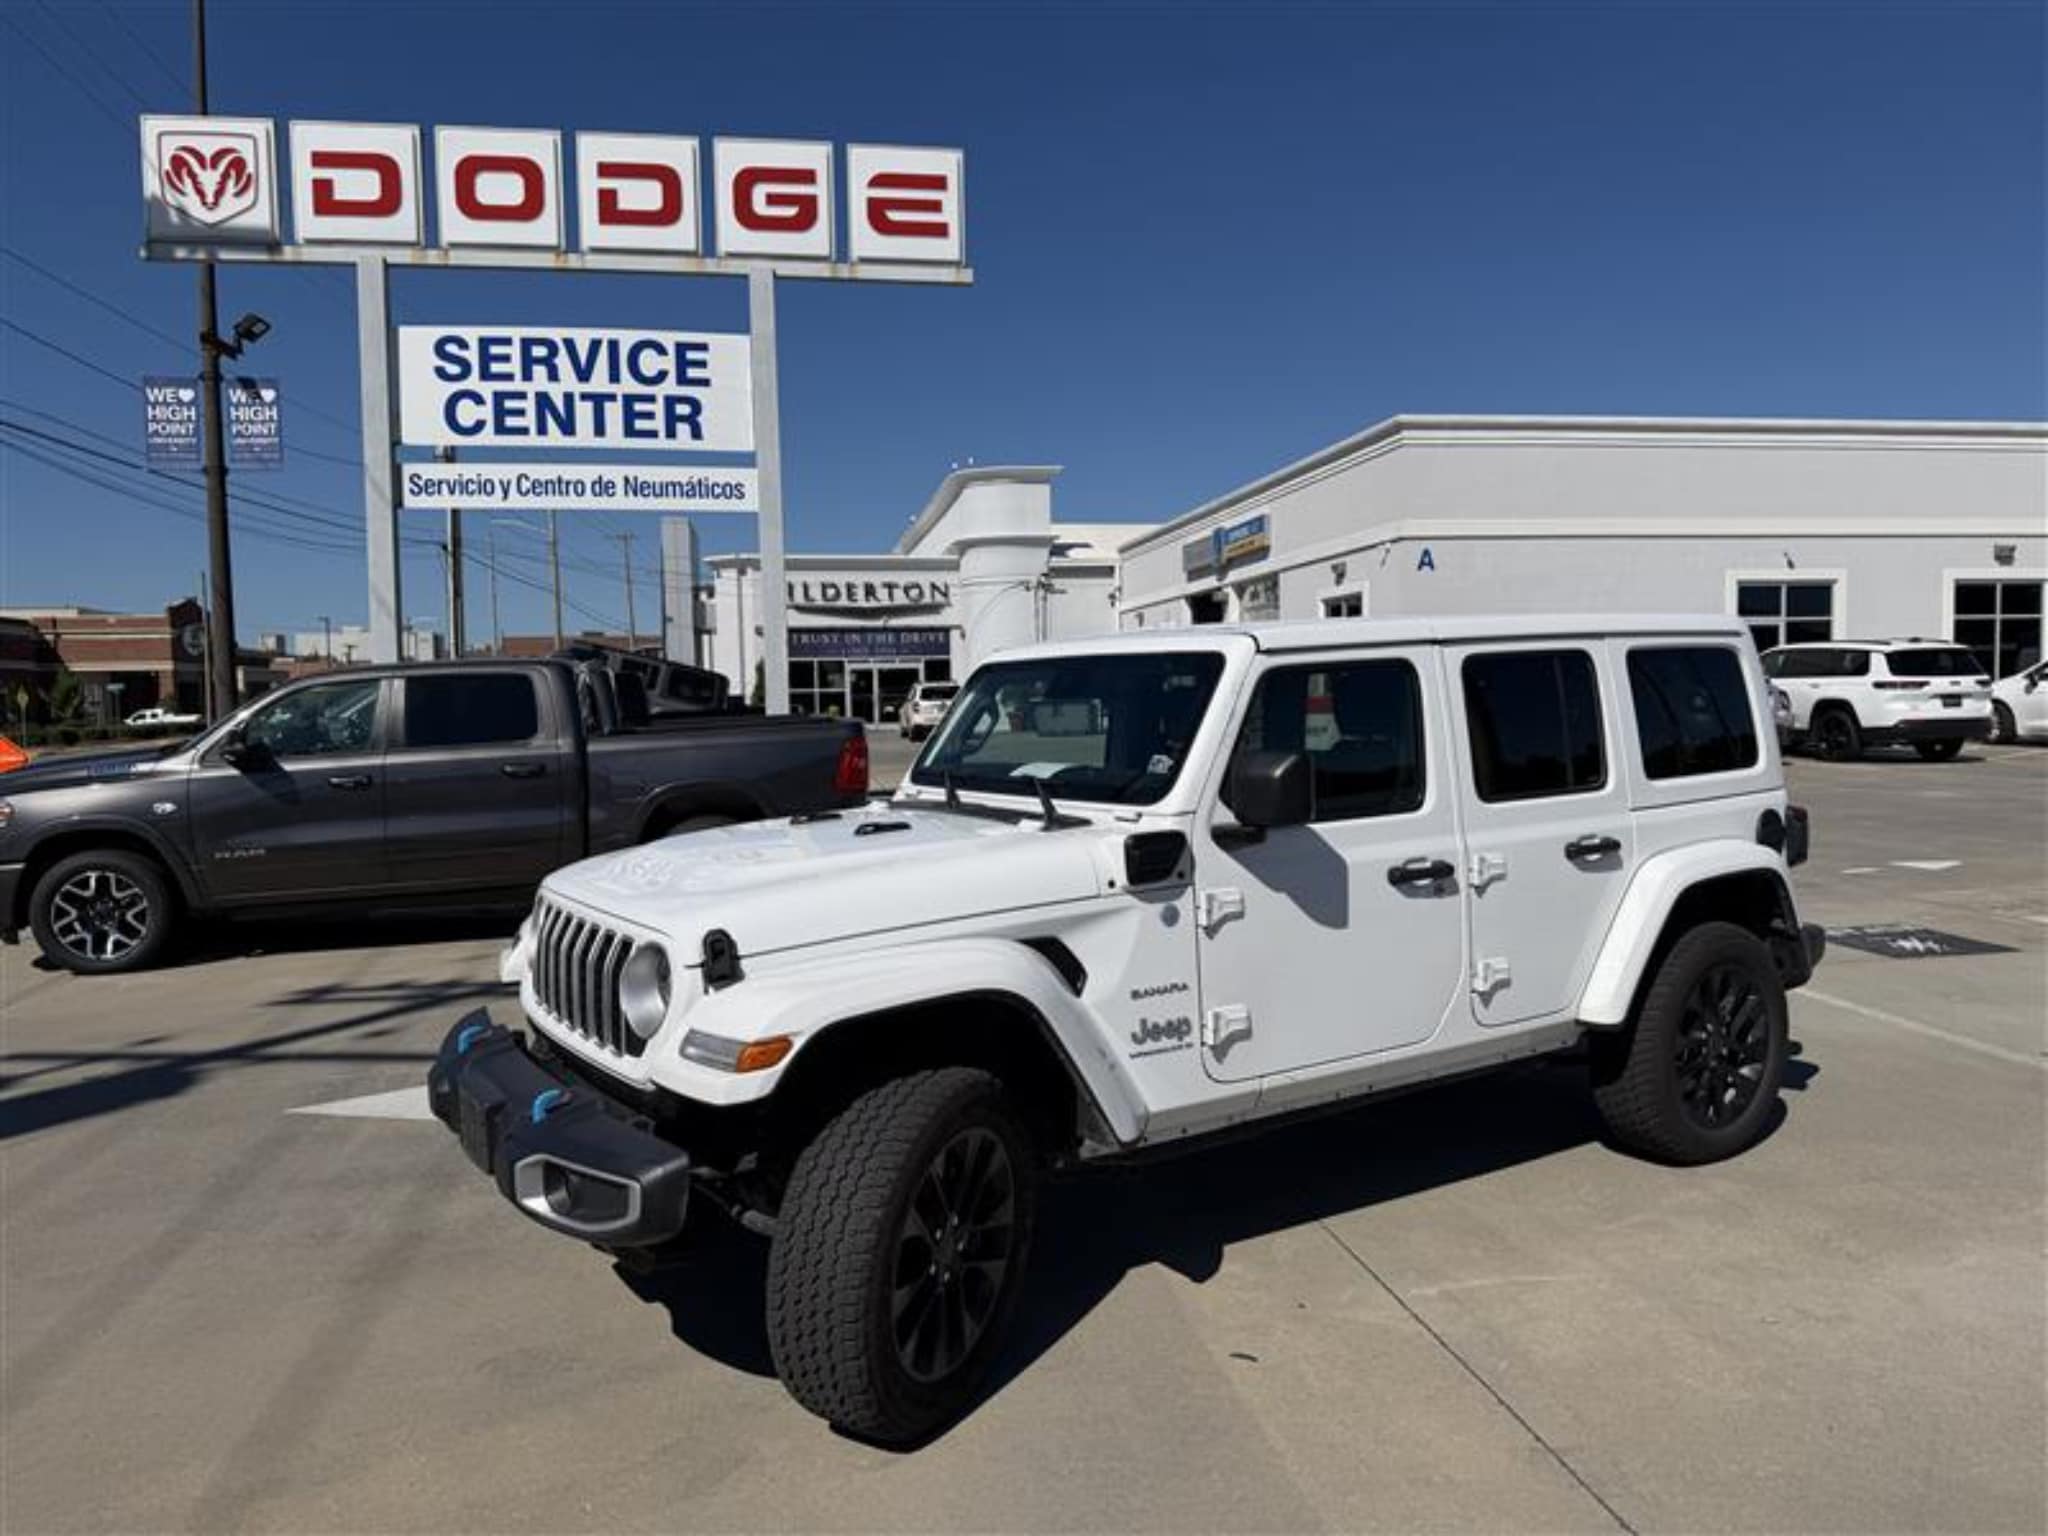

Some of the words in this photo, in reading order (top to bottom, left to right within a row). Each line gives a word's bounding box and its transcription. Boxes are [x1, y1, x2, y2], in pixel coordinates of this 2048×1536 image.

[310, 150, 949, 238] DODGE
[432, 334, 712, 388] SERVICE
[145, 386, 178, 403] WE
[146, 404, 197, 421] HIGH
[229, 405, 278, 421] HIGH
[442, 388, 704, 441] CENTER
[147, 421, 196, 437] POINT
[231, 421, 277, 436] POINT
[408, 472, 496, 498] Servicio
[498, 479, 513, 502] y
[516, 473, 586, 498] Centro
[590, 474, 617, 498] de
[623, 475, 746, 501] Neumáticos
[1418, 548, 1435, 571] A
[787, 581, 949, 602] ILDERTON
[792, 632, 840, 645] TRUST
[844, 633, 862, 645] IN
[865, 632, 897, 645] THE
[900, 631, 946, 645] DRIVE
[1131, 1017, 1192, 1044] Jeep
